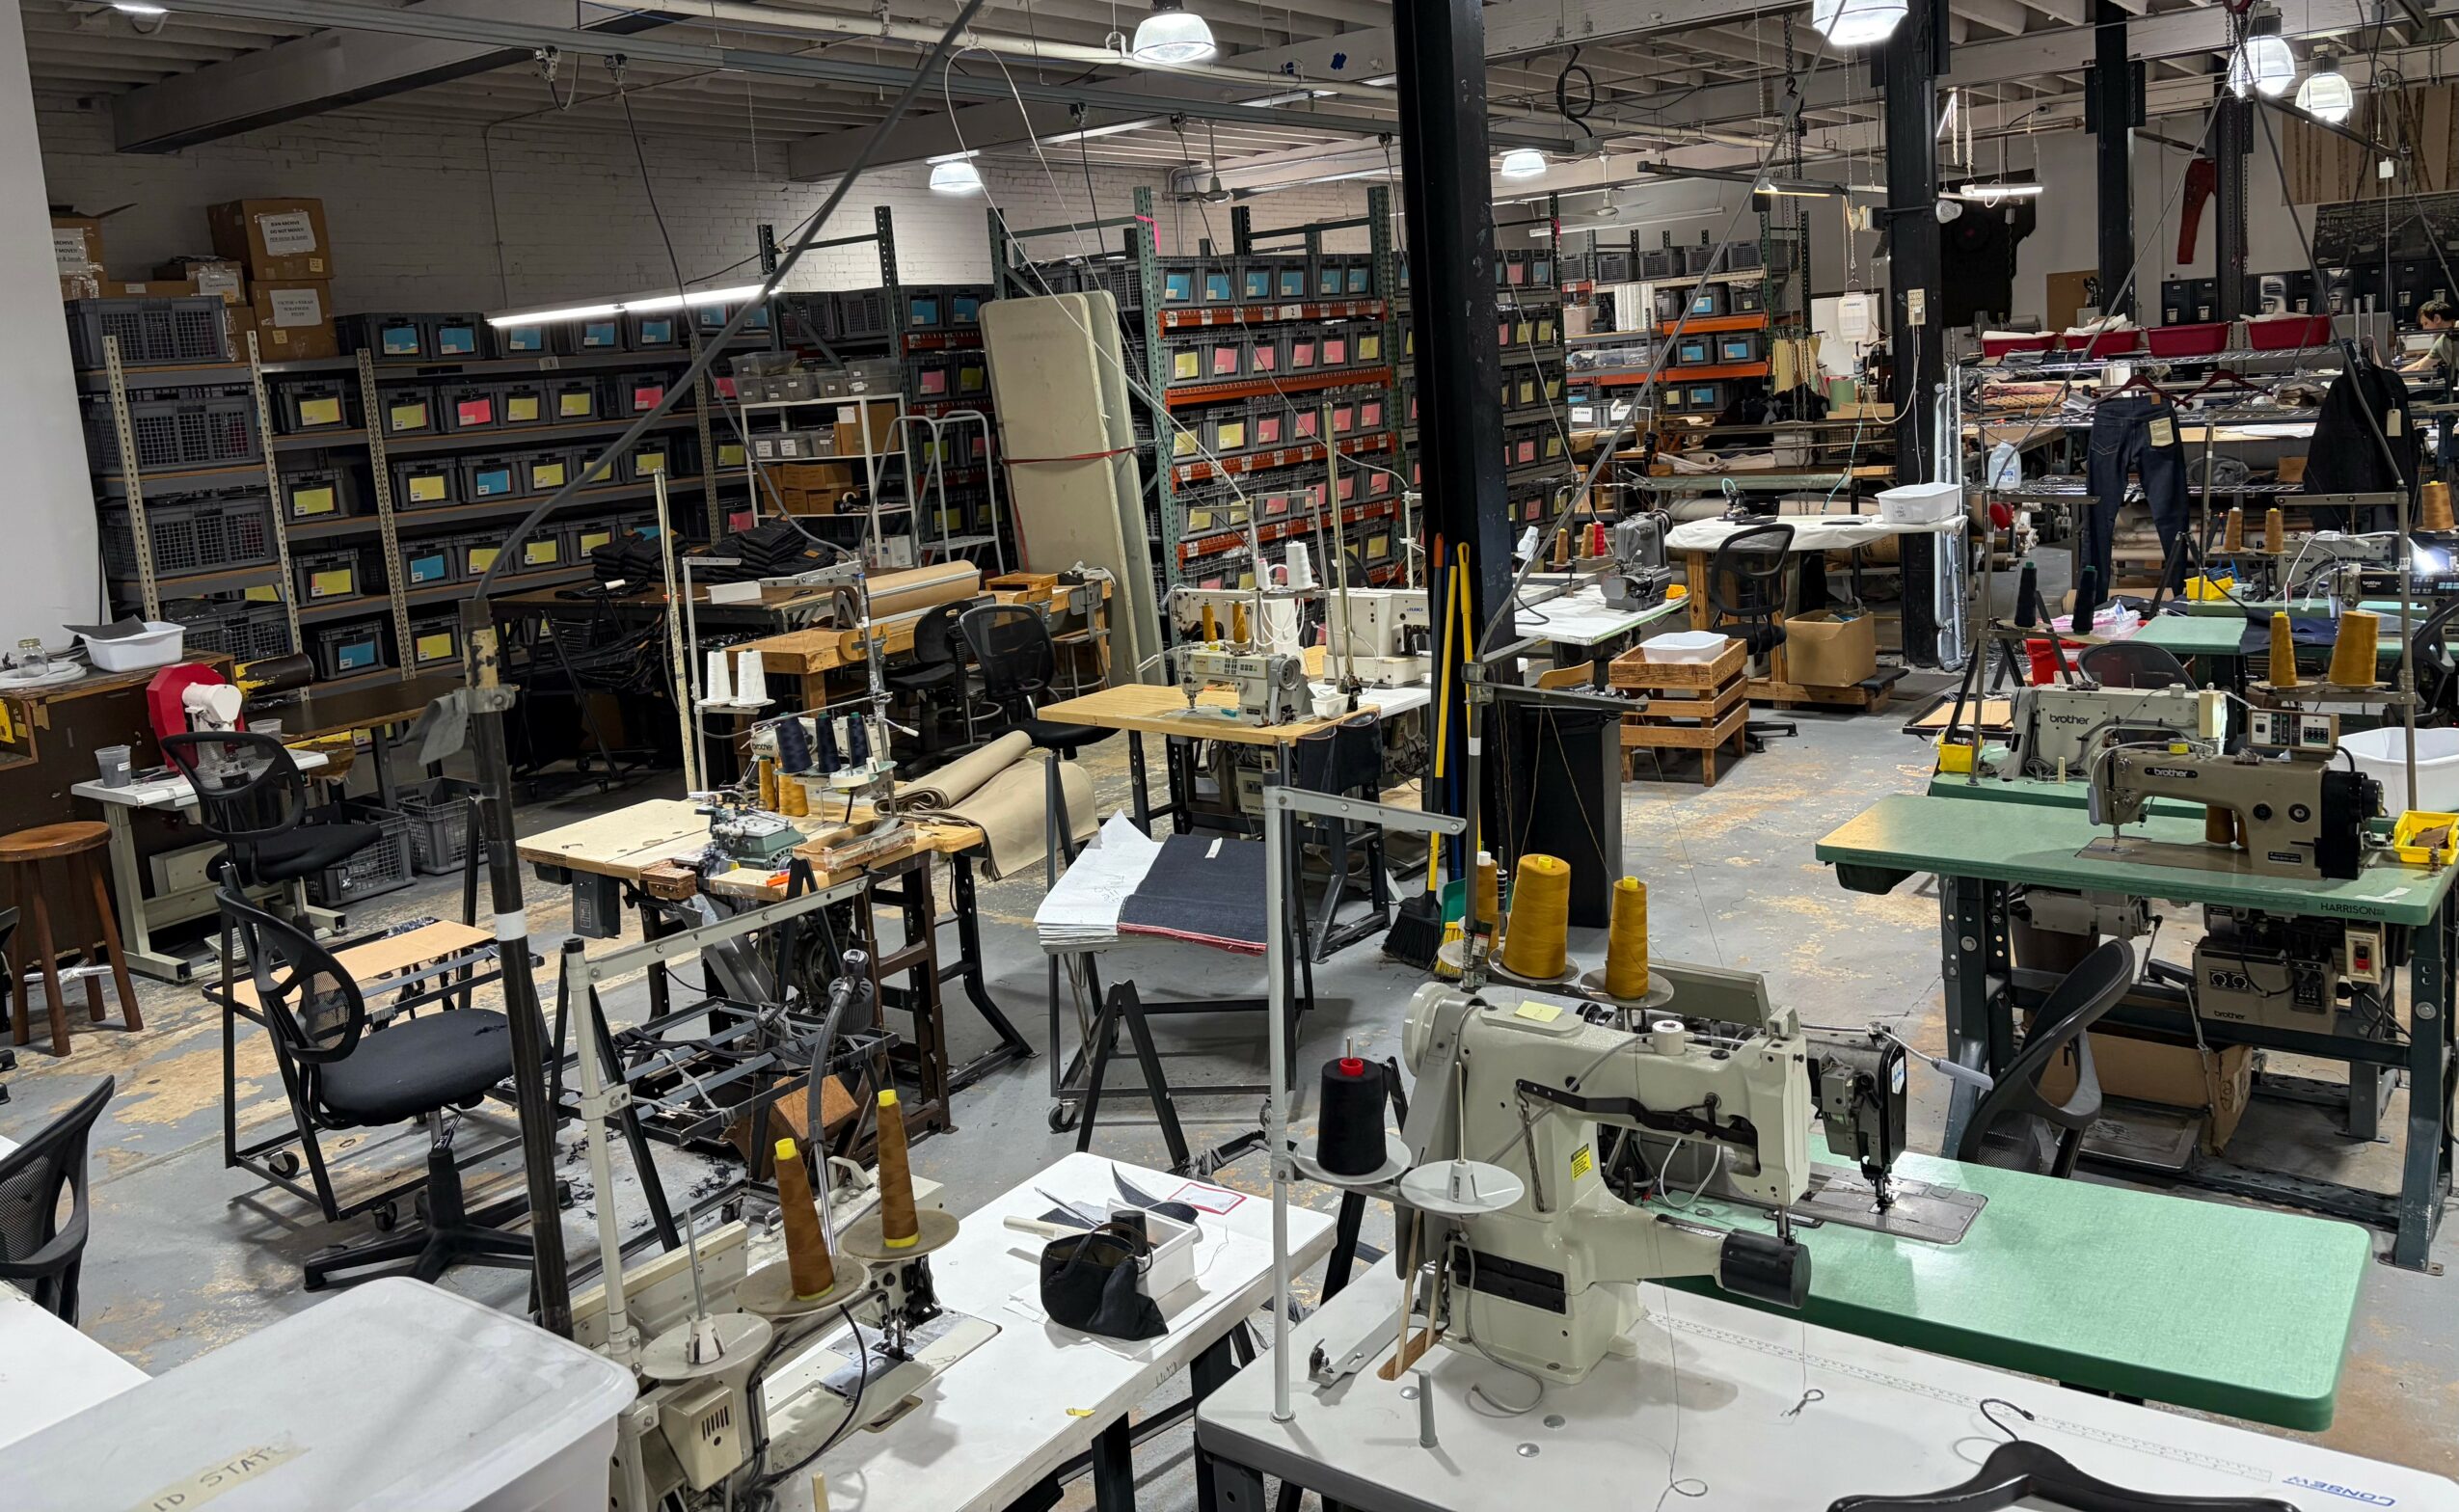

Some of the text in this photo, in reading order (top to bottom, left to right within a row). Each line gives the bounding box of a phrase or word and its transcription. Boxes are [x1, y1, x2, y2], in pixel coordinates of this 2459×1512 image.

[2049, 714, 2090, 724] brother
[2153, 769, 2188, 777] brother
[2320, 903, 2376, 916] HARRISON
[2214, 1010, 2245, 1019] brother
